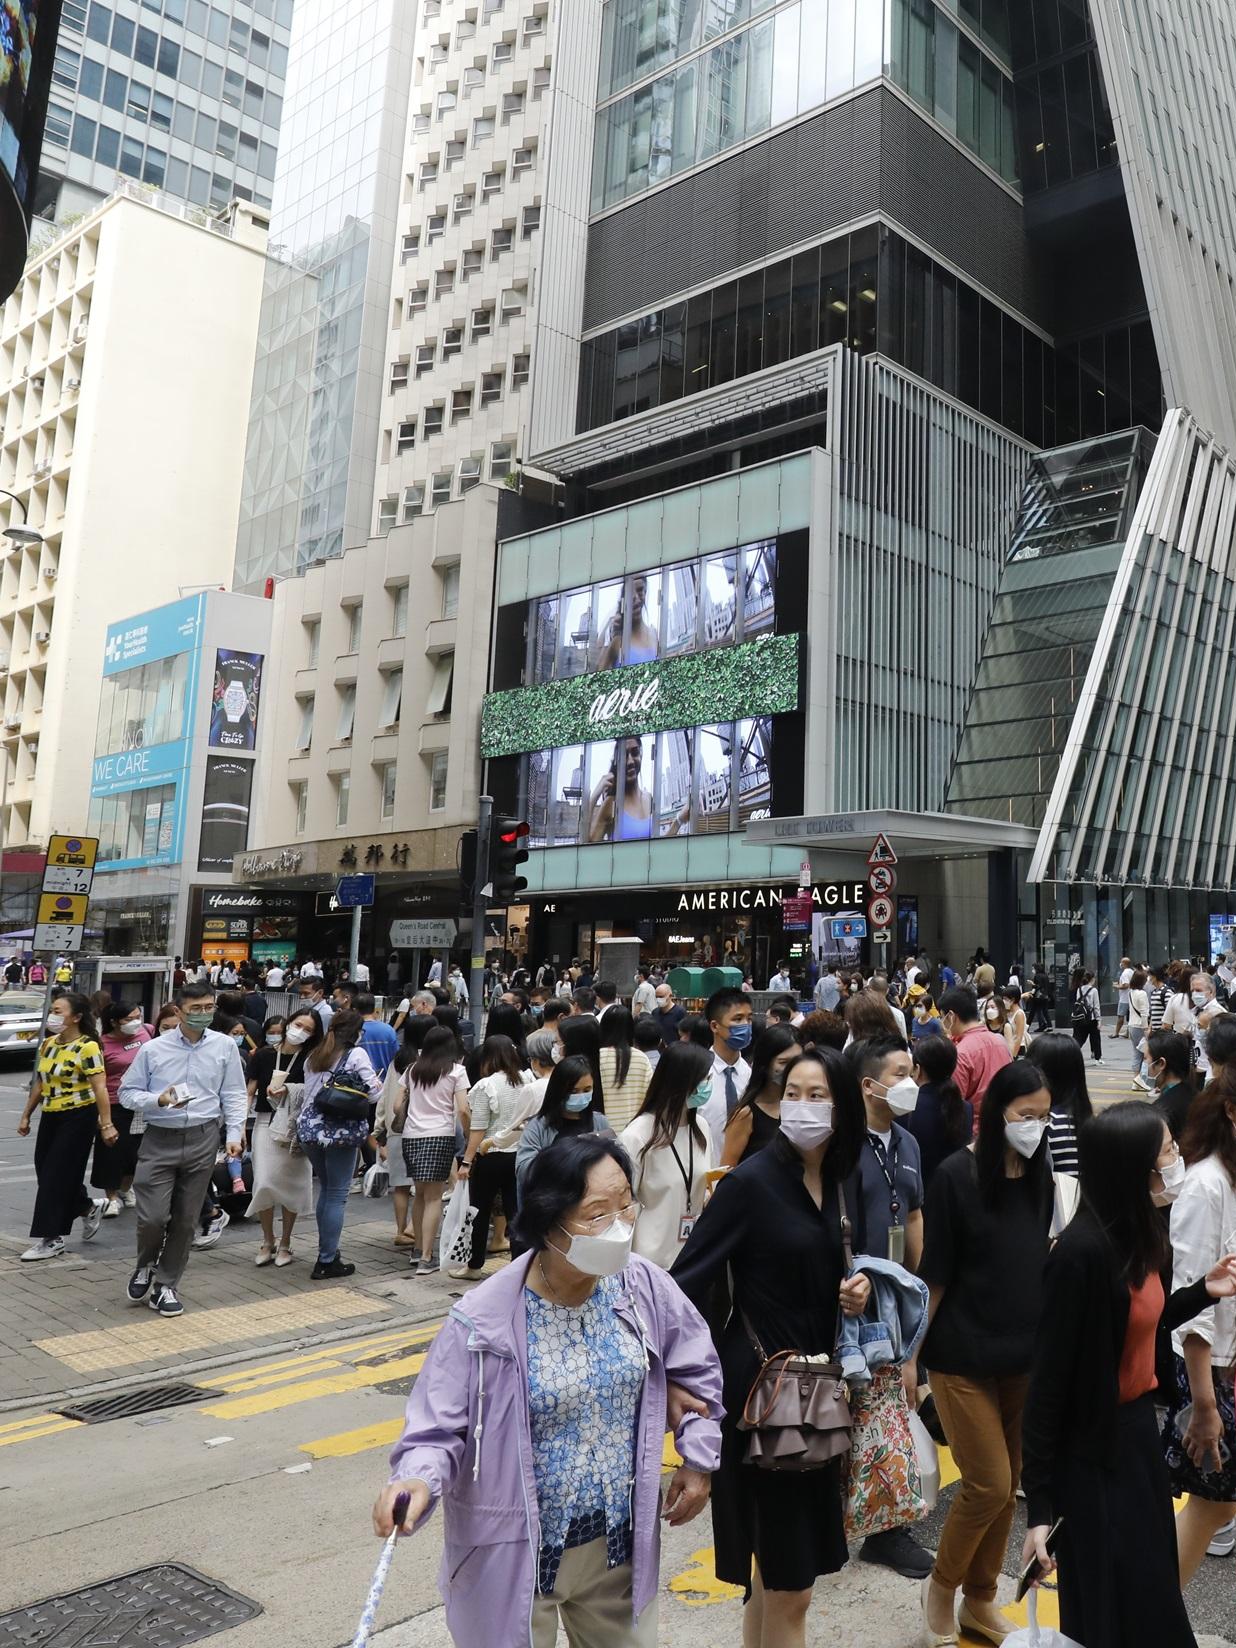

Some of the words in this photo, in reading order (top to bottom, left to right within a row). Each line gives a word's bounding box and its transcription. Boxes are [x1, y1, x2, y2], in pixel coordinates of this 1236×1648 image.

[588, 670, 660, 723] aerie
[94, 758, 114, 782] WE
[116, 750, 151, 777] CARE
[75, 869, 84, 878] 7
[73, 883, 88, 892] 12
[209, 894, 263, 908] Homebake
[678, 888, 783, 911] AMERICAN
[543, 904, 556, 913] AE
[66, 926, 75, 935] 7
[64, 940, 73, 949] 7
